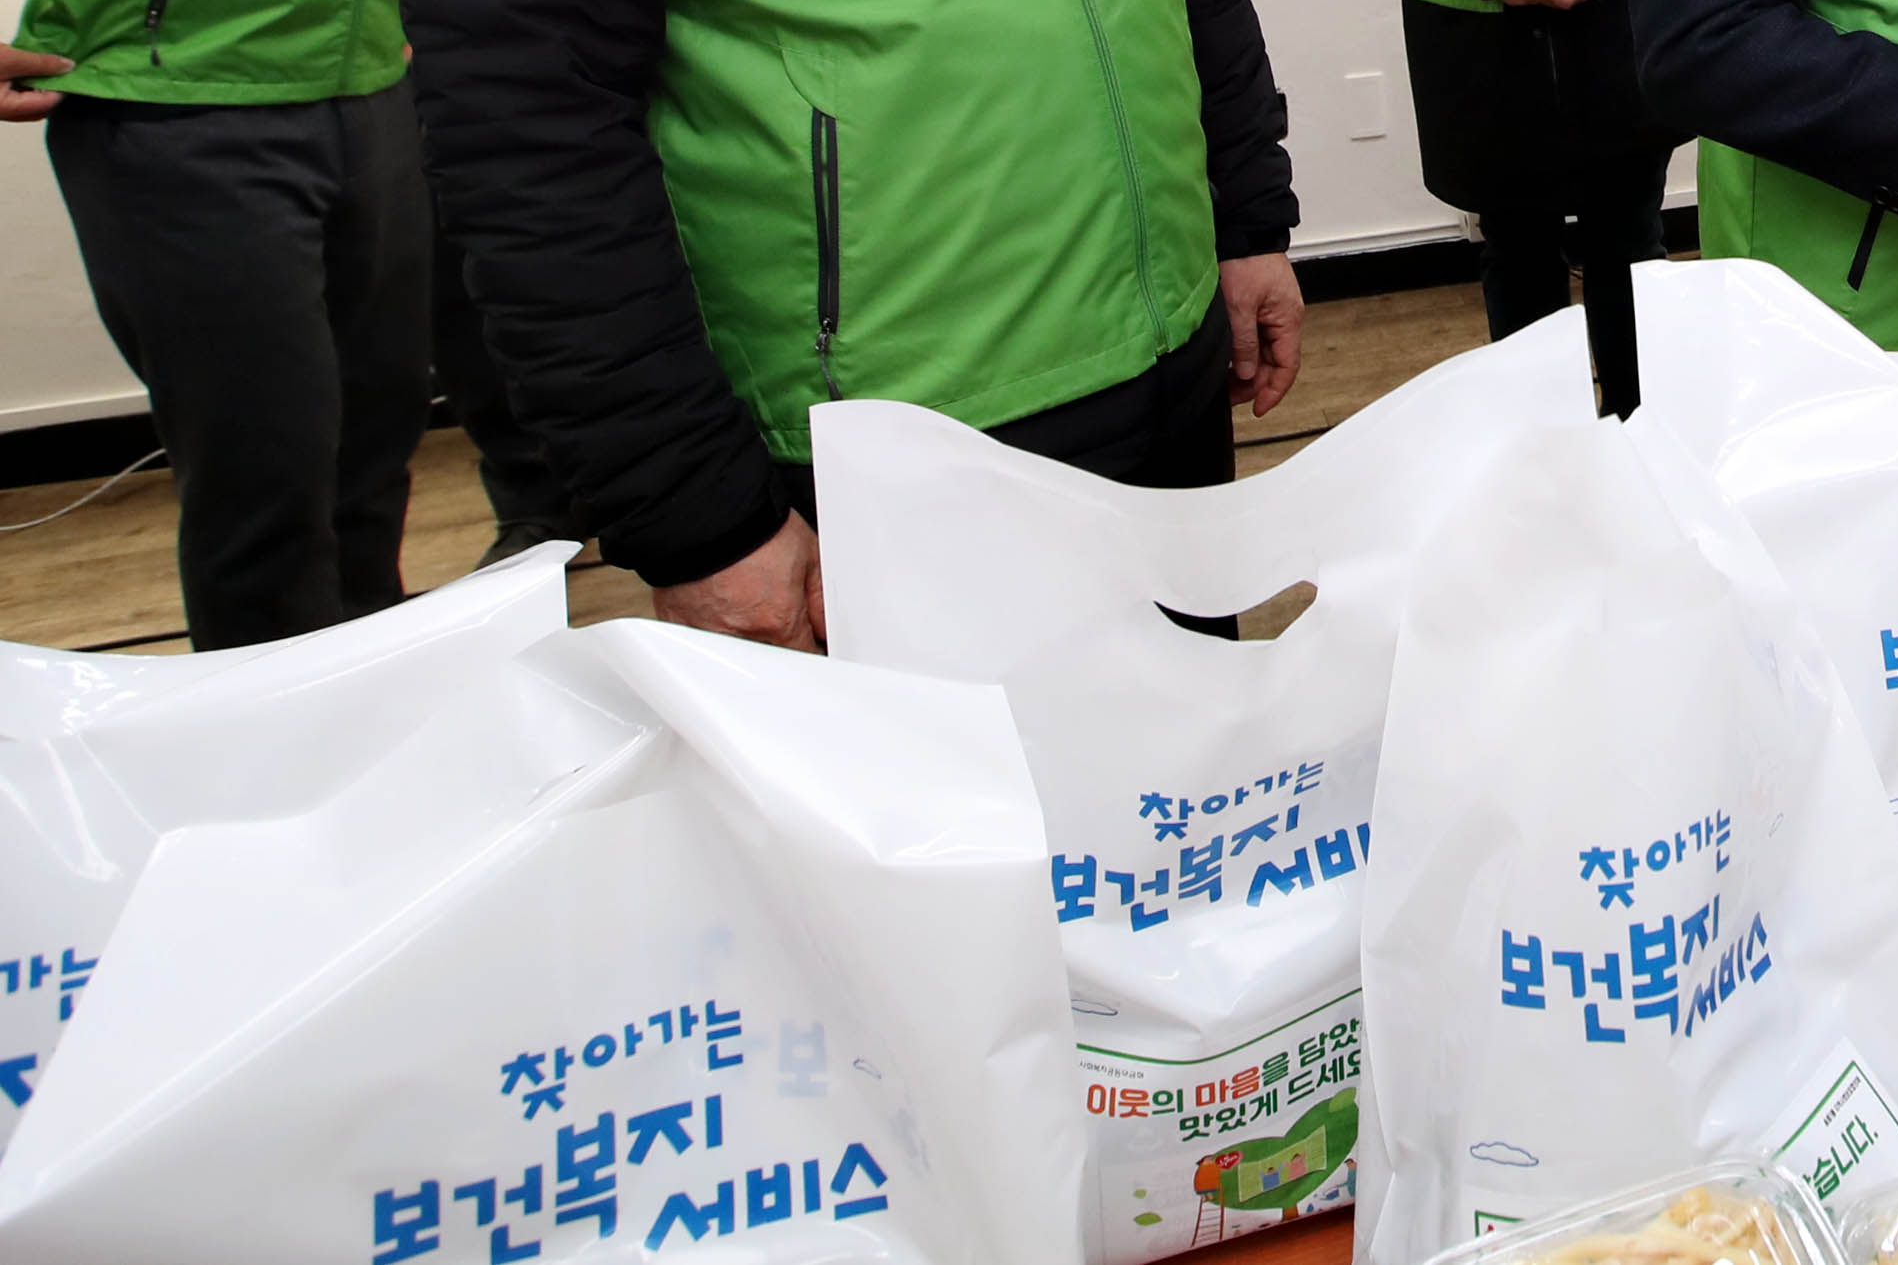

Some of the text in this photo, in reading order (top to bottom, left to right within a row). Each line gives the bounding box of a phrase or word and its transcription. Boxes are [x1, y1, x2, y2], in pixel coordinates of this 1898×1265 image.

[1138, 761, 1325, 843] 찾아가는
[1051, 803, 1301, 933] 보건복지
[1579, 808, 1731, 911] 찾아가는
[1501, 892, 1772, 1044] 보건복지 서비스
[500, 999, 744, 1122] 찾아가는
[1086, 1083, 1184, 1119] 이웃의
[1195, 1050, 1290, 1108] 마음을
[1178, 1088, 1279, 1142] 맛있게
[1802, 1114, 1880, 1202] 습니다.
[372, 1093, 889, 1265] 보건복지 서비스
